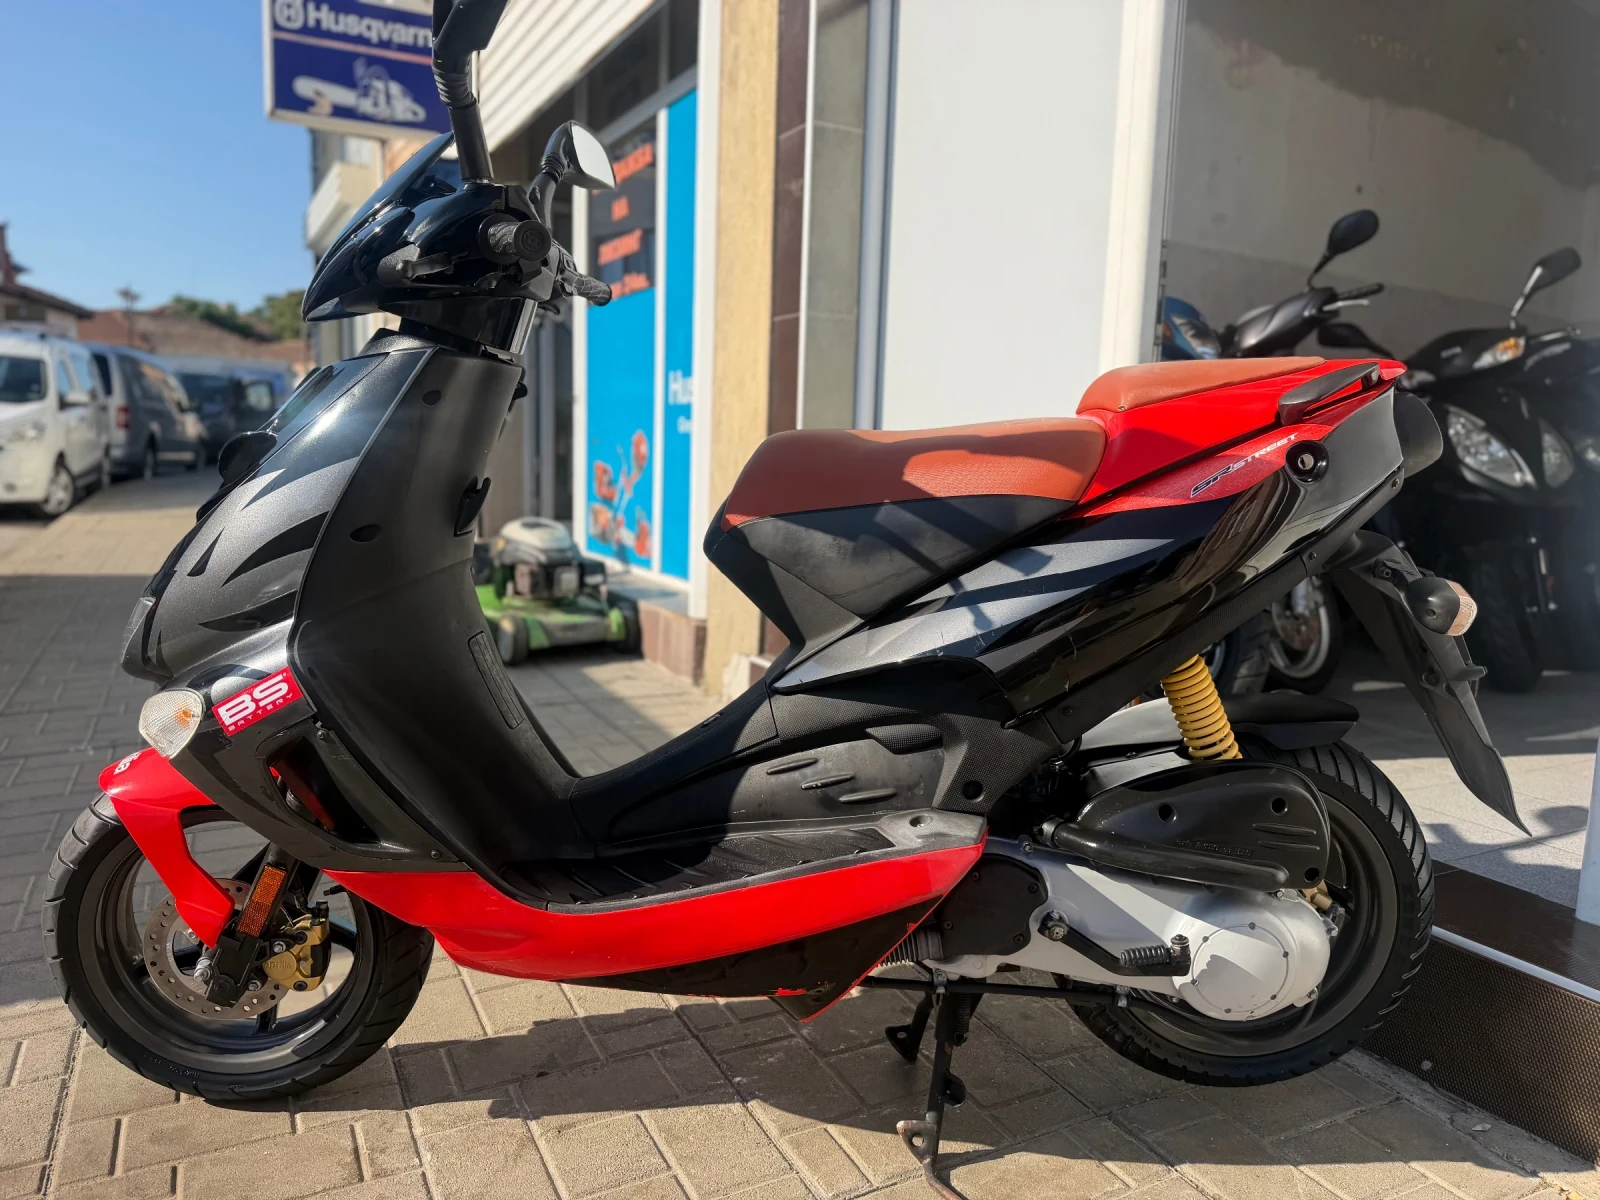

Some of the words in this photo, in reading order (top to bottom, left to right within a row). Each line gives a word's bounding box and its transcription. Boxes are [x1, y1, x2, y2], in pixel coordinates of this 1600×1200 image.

[1231, 432, 1298, 470] STREET
[217, 673, 289, 726] BS
[228, 693, 293, 732] BATTERY
[264, 960, 292, 970] aprilia
